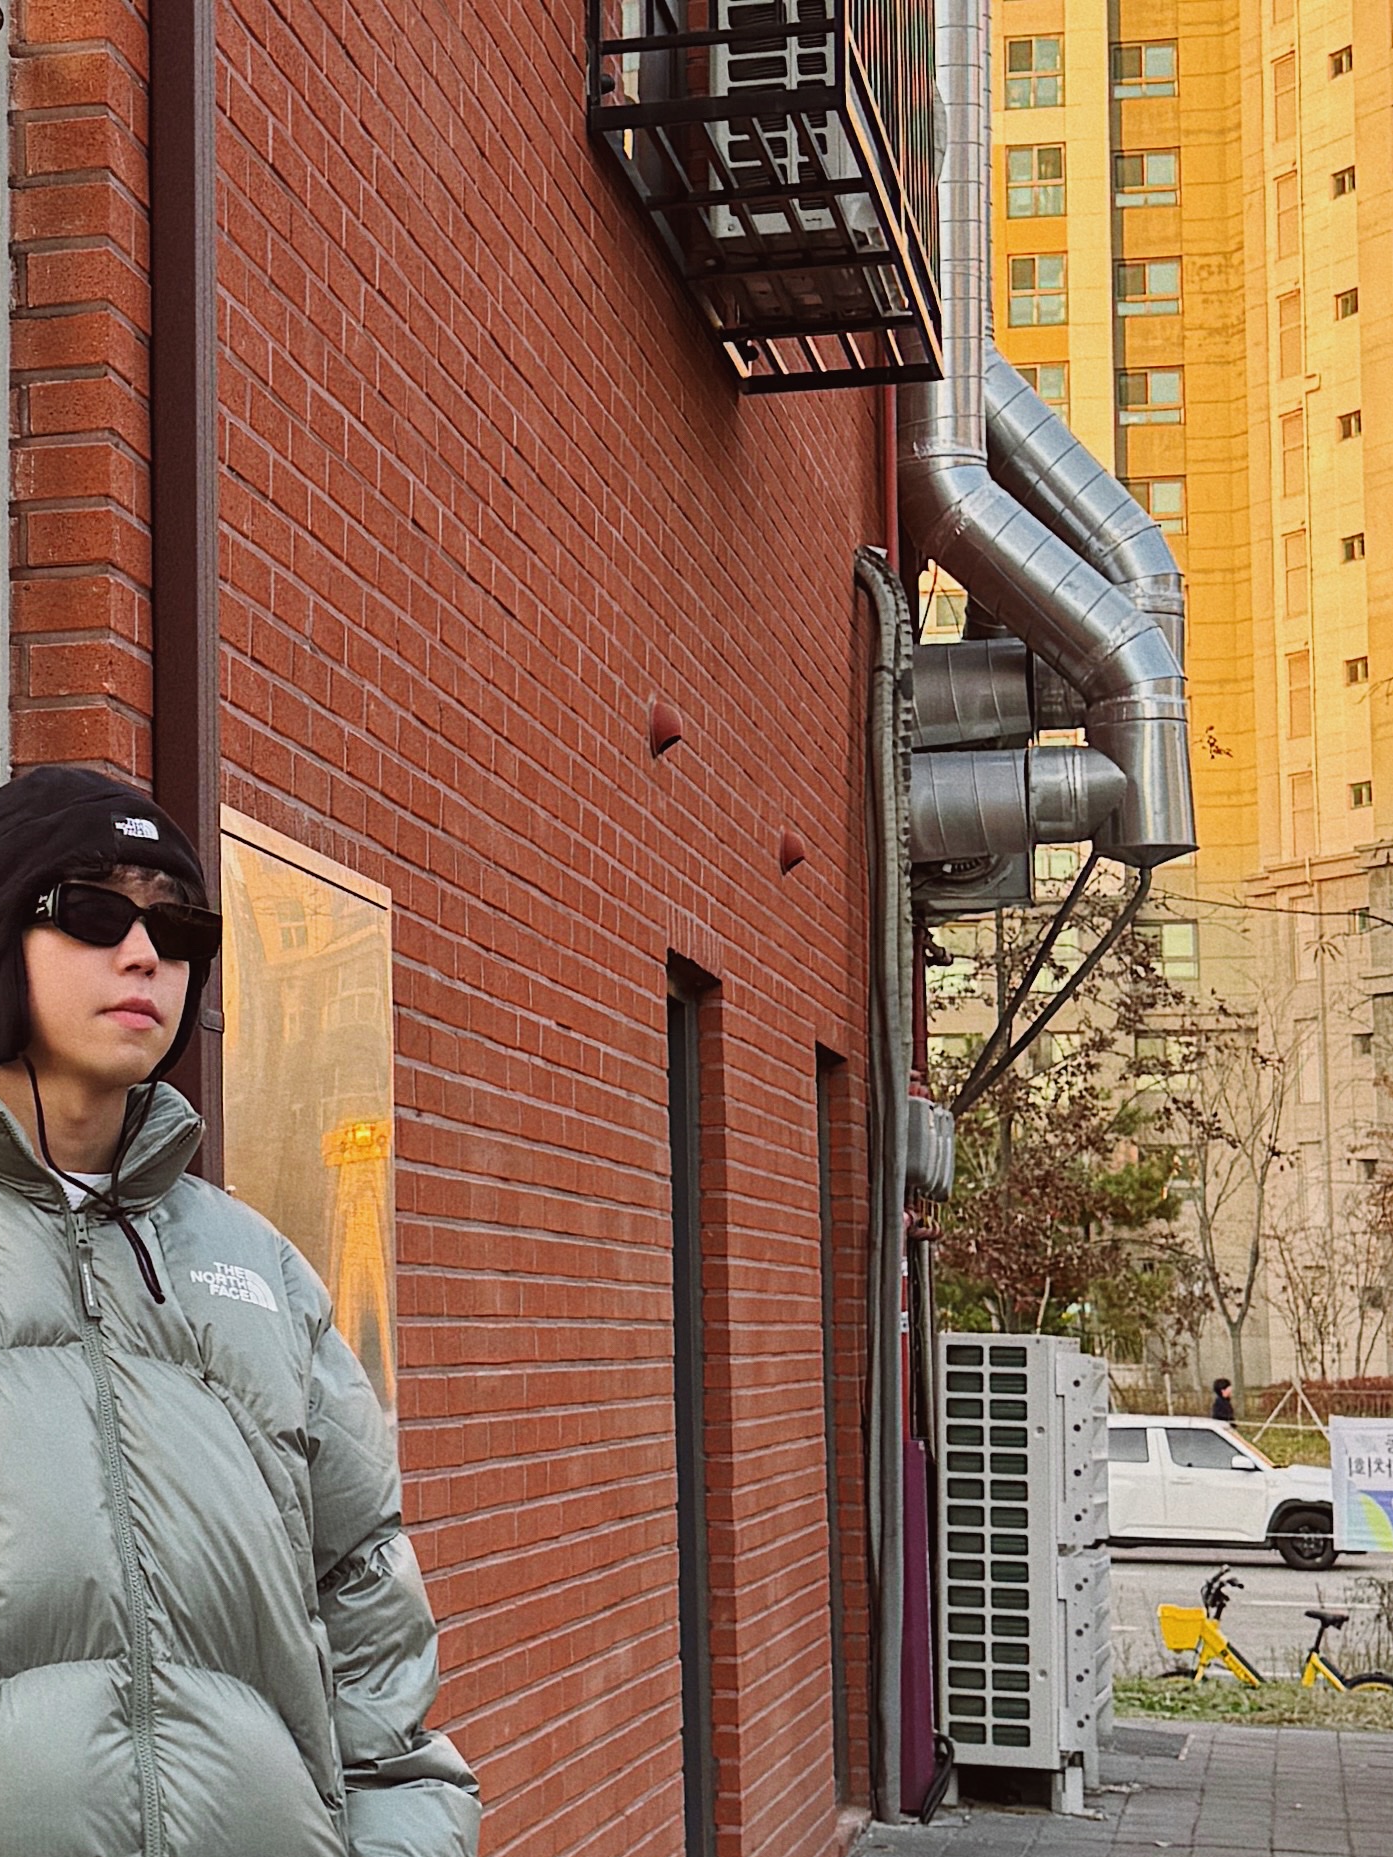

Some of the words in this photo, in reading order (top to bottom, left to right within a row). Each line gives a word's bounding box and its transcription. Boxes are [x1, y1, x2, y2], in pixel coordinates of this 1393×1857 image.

[189, 1269, 248, 1290] NORTH
[213, 1261, 246, 1280] THE
[209, 1283, 251, 1303] FACE
